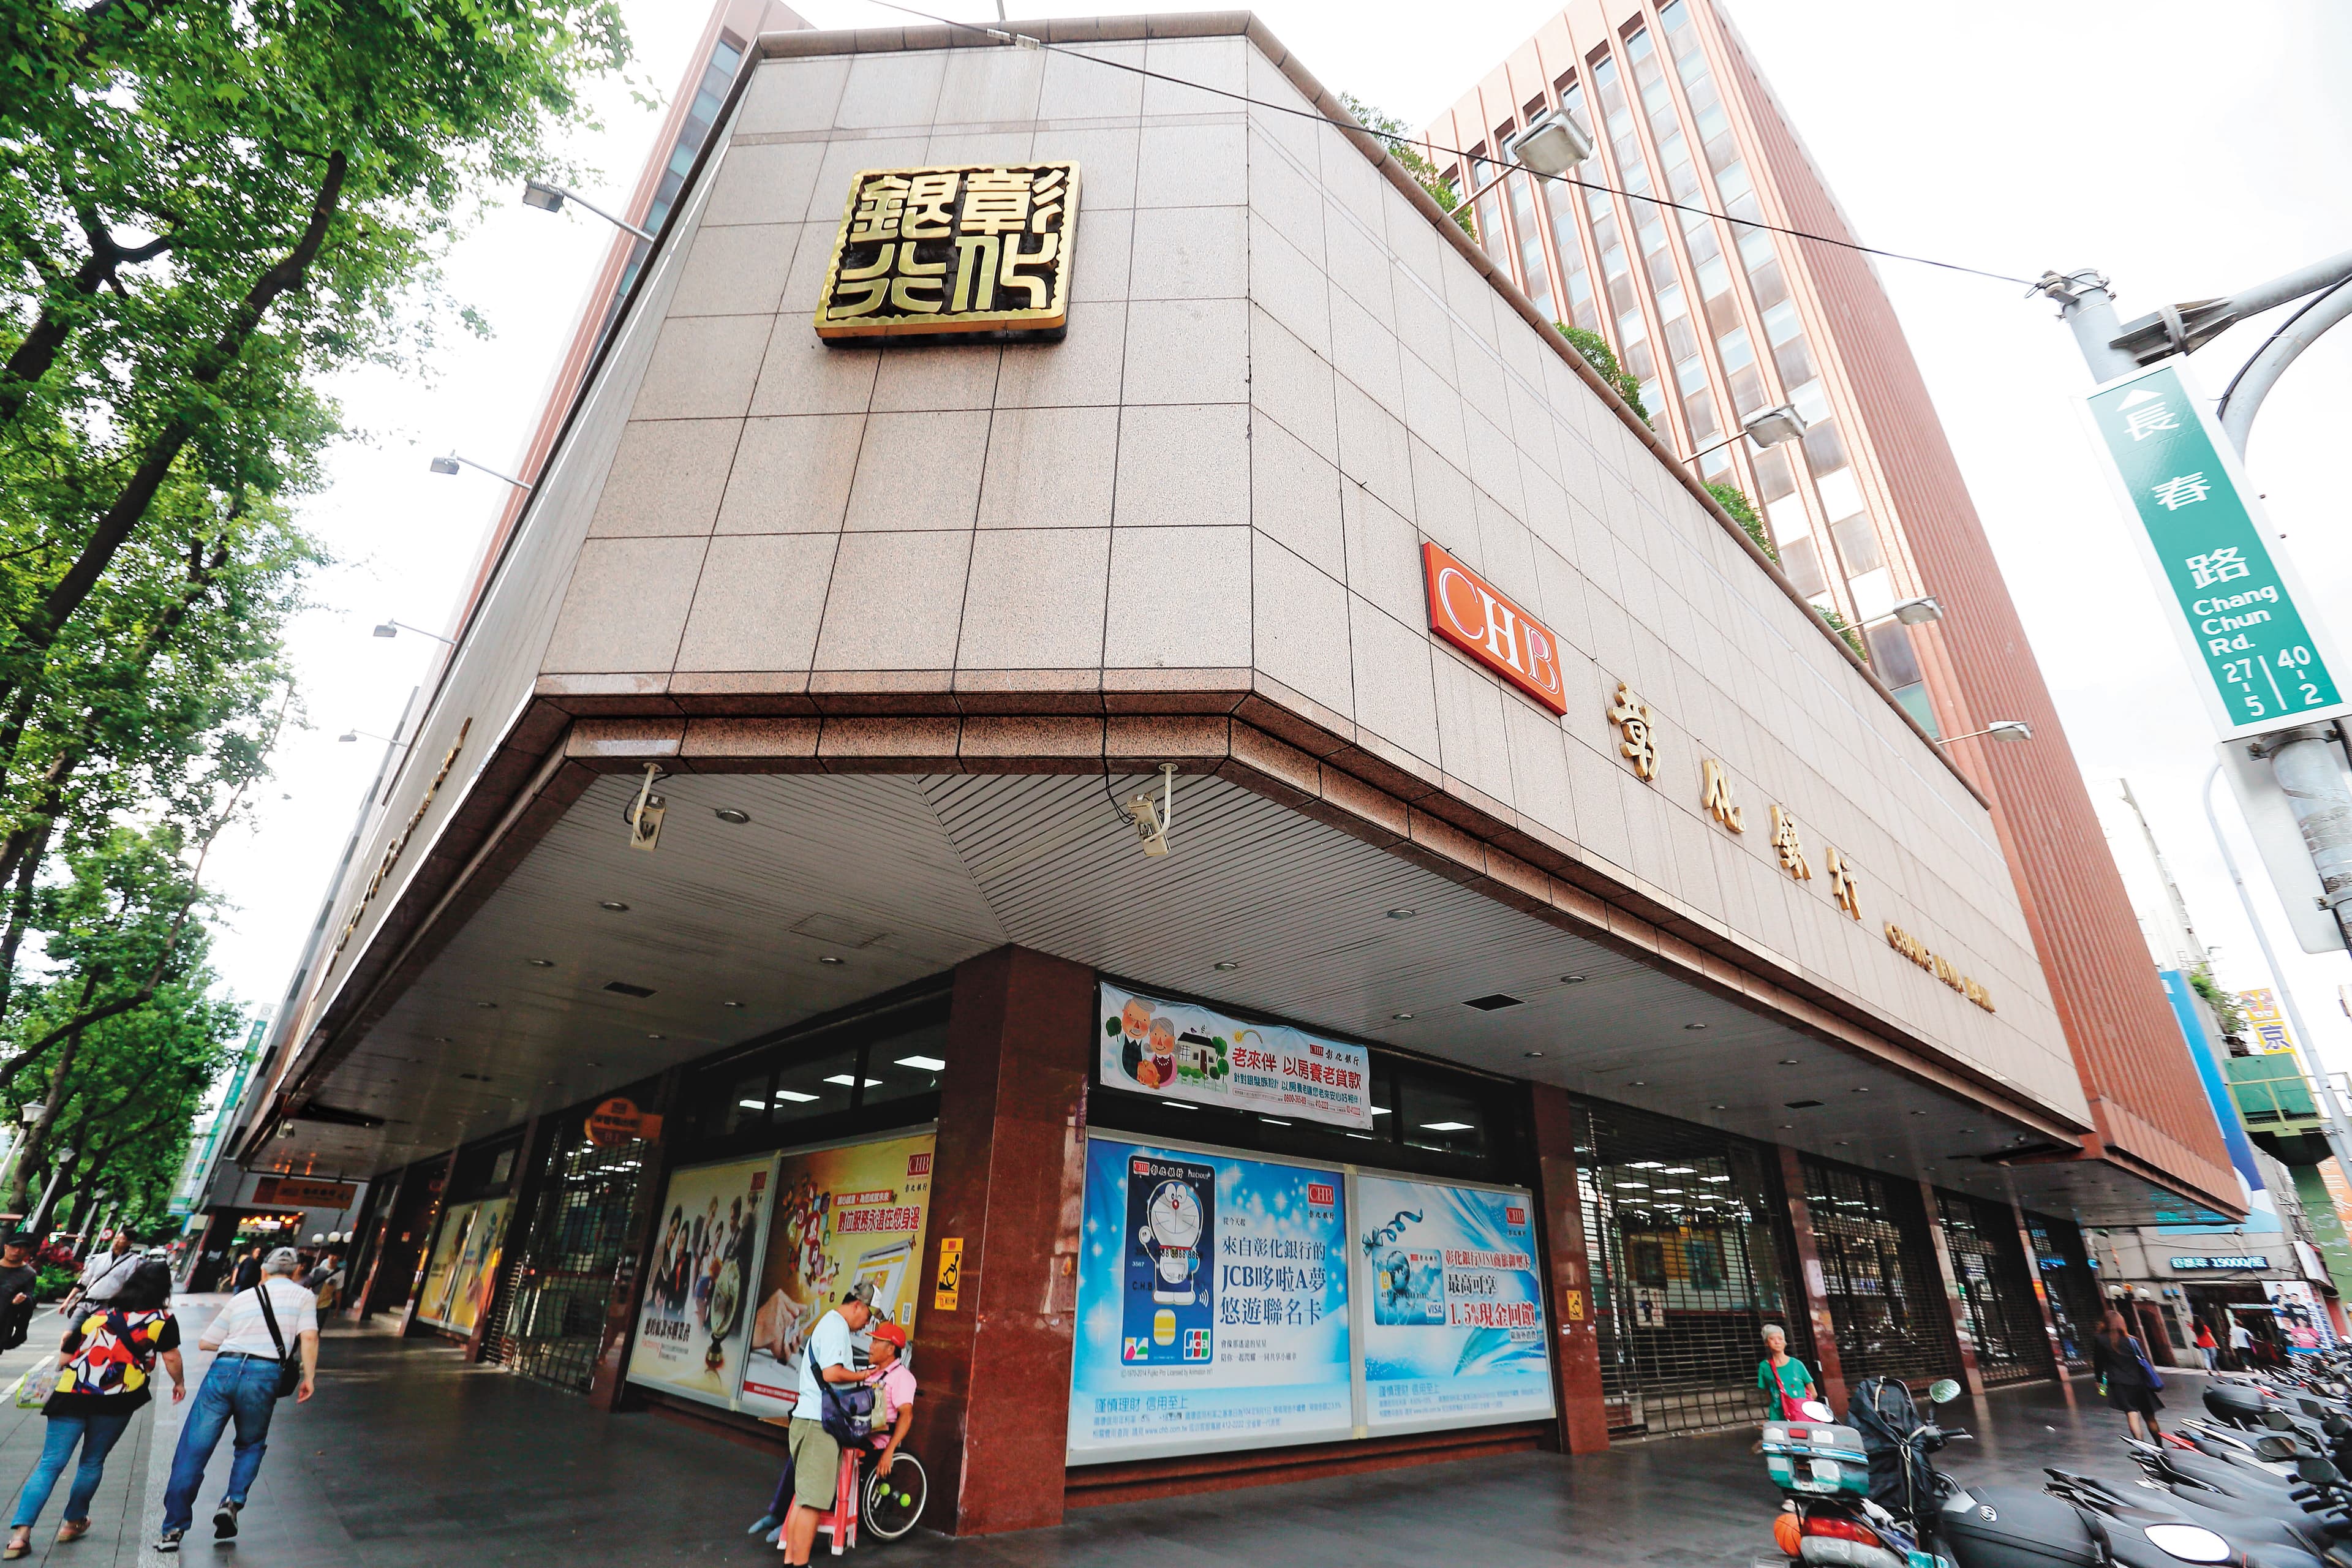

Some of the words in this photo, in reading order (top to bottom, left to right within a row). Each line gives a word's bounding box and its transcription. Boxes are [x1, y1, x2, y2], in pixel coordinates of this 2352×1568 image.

[2124, 401, 2250, 589] 長春路
[2193, 585, 2279, 616] Chang
[1439, 567, 1559, 695] CHB
[2201, 609, 2272, 636] Chun
[2207, 633, 2256, 657] Rd.
[1607, 682, 1863, 921] 彰化銀行
[2259, 1025, 2290, 1049] 京
[1232, 1047, 1277, 1072] 老來伴
[1283, 1055, 1361, 1090] 以房養老貸款
[1325, 1049, 1359, 1067] 彰化銀行
[909, 1156, 929, 1173] CHB
[1151, 1164, 1183, 1179] 彰化銀行
[1310, 1186, 1333, 1203] CHB
[837, 1207, 920, 1232] 數位服務永遠在您身邊
[1223, 1217, 1246, 1226] 從今天起
[1309, 1210, 1335, 1219] 彰化銀行
[1507, 1209, 1525, 1223] CHB
[1222, 1236, 1326, 1261] 來自彰化銀行的
[1222, 1265, 1326, 1292] JCB哆啦A夢
[1449, 1274, 1496, 1294] 最高可享
[1220, 1297, 1322, 1325] 悠遊聯名卡
[1428, 1305, 1442, 1314] VISA
[1095, 1397, 1140, 1413] 謹慎理財
[1147, 1395, 1188, 1411] 信用至上
